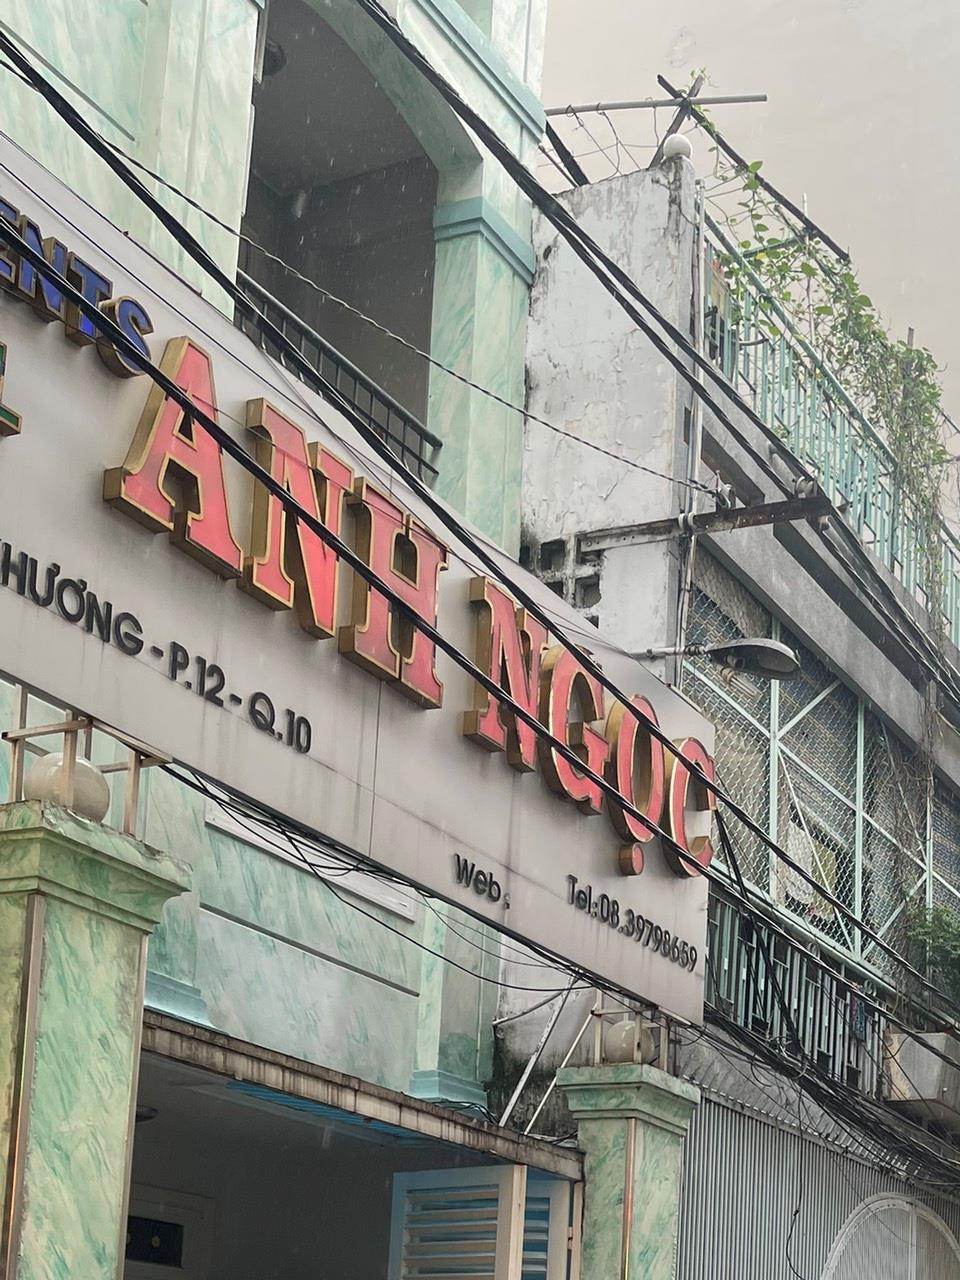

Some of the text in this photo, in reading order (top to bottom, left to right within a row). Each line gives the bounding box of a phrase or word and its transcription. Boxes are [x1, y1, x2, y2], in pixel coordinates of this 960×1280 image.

[0, 537, 144, 656] HƯƠNG
[103, 336, 718, 879] ANH NGỌC
